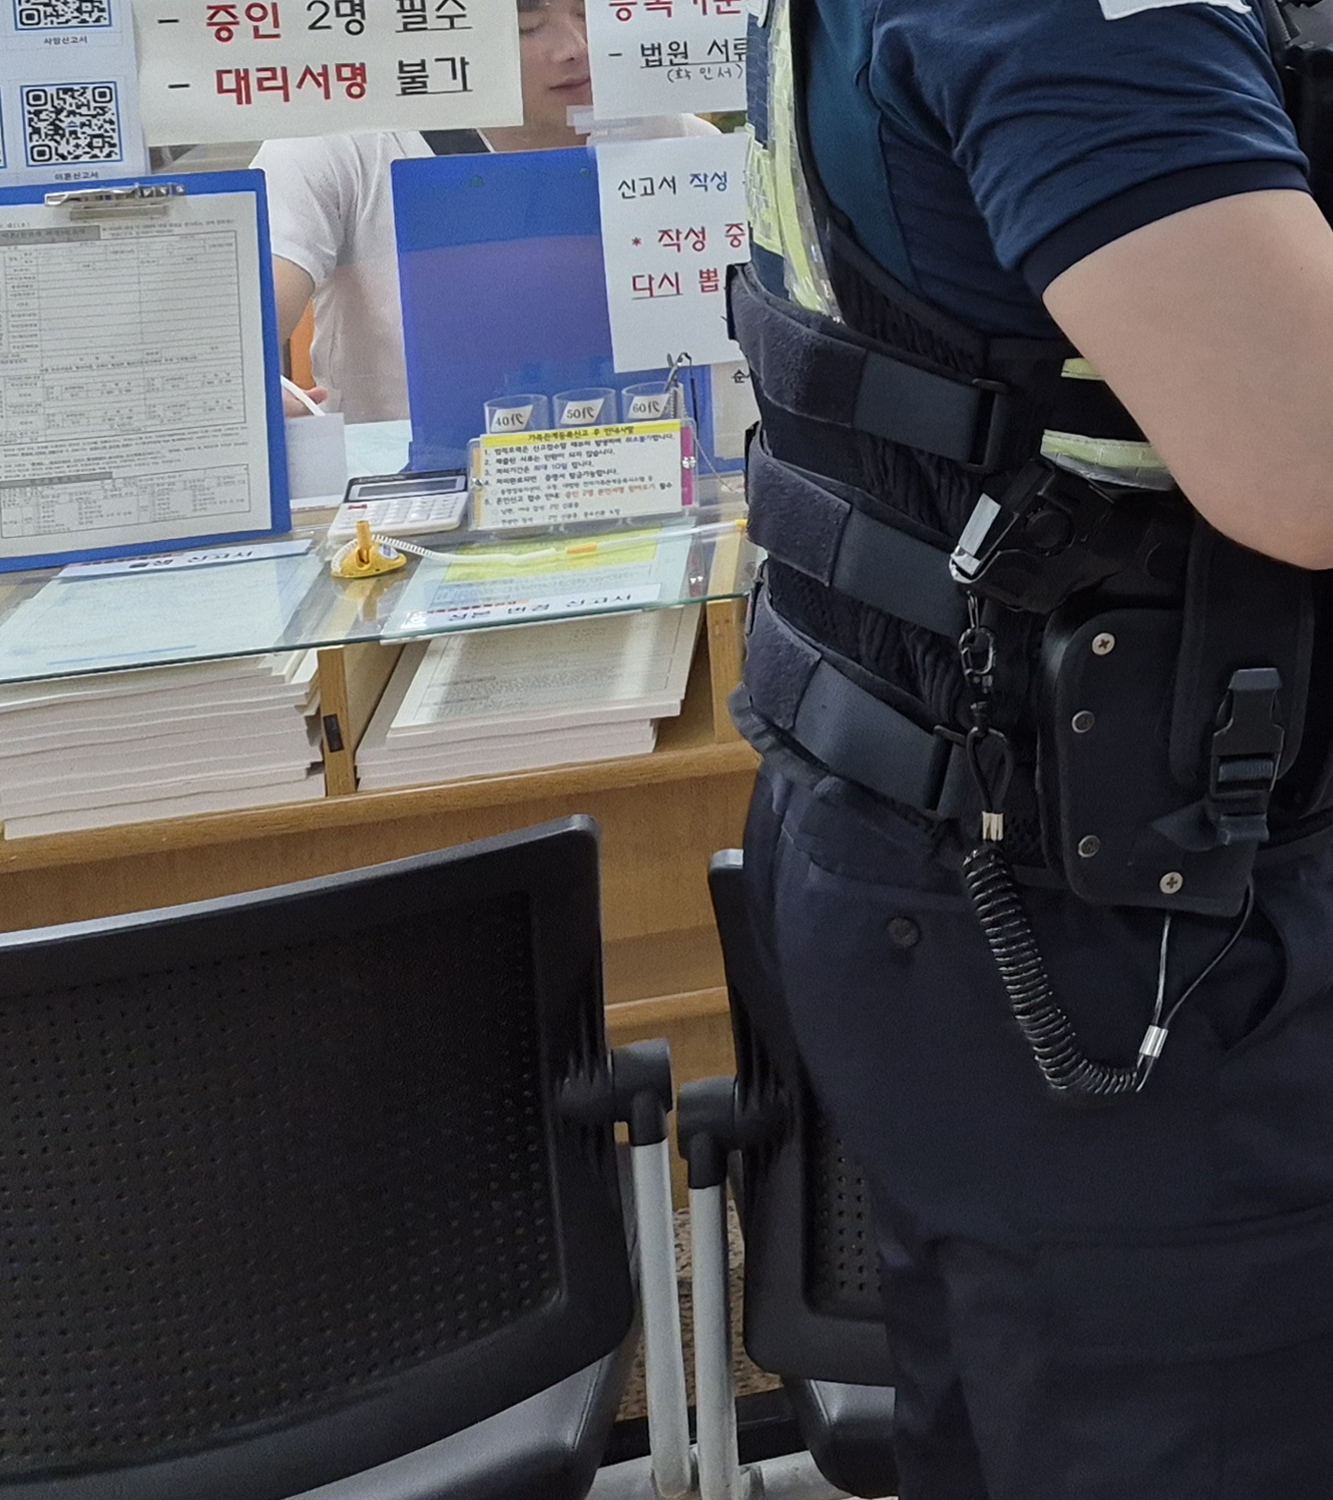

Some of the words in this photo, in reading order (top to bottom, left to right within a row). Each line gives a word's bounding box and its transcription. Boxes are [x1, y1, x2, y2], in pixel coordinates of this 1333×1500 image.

[205, 1, 282, 43] 증인
[640, 40, 689, 67] 법원
[215, 62, 368, 105] 대리서명
[397, 56, 472, 97] 불가
[618, 175, 677, 199] 신고서
[689, 171, 728, 192] 작성
[657, 226, 707, 253] 작성
[724, 223, 746, 248] 중
[632, 271, 683, 300] 다시
